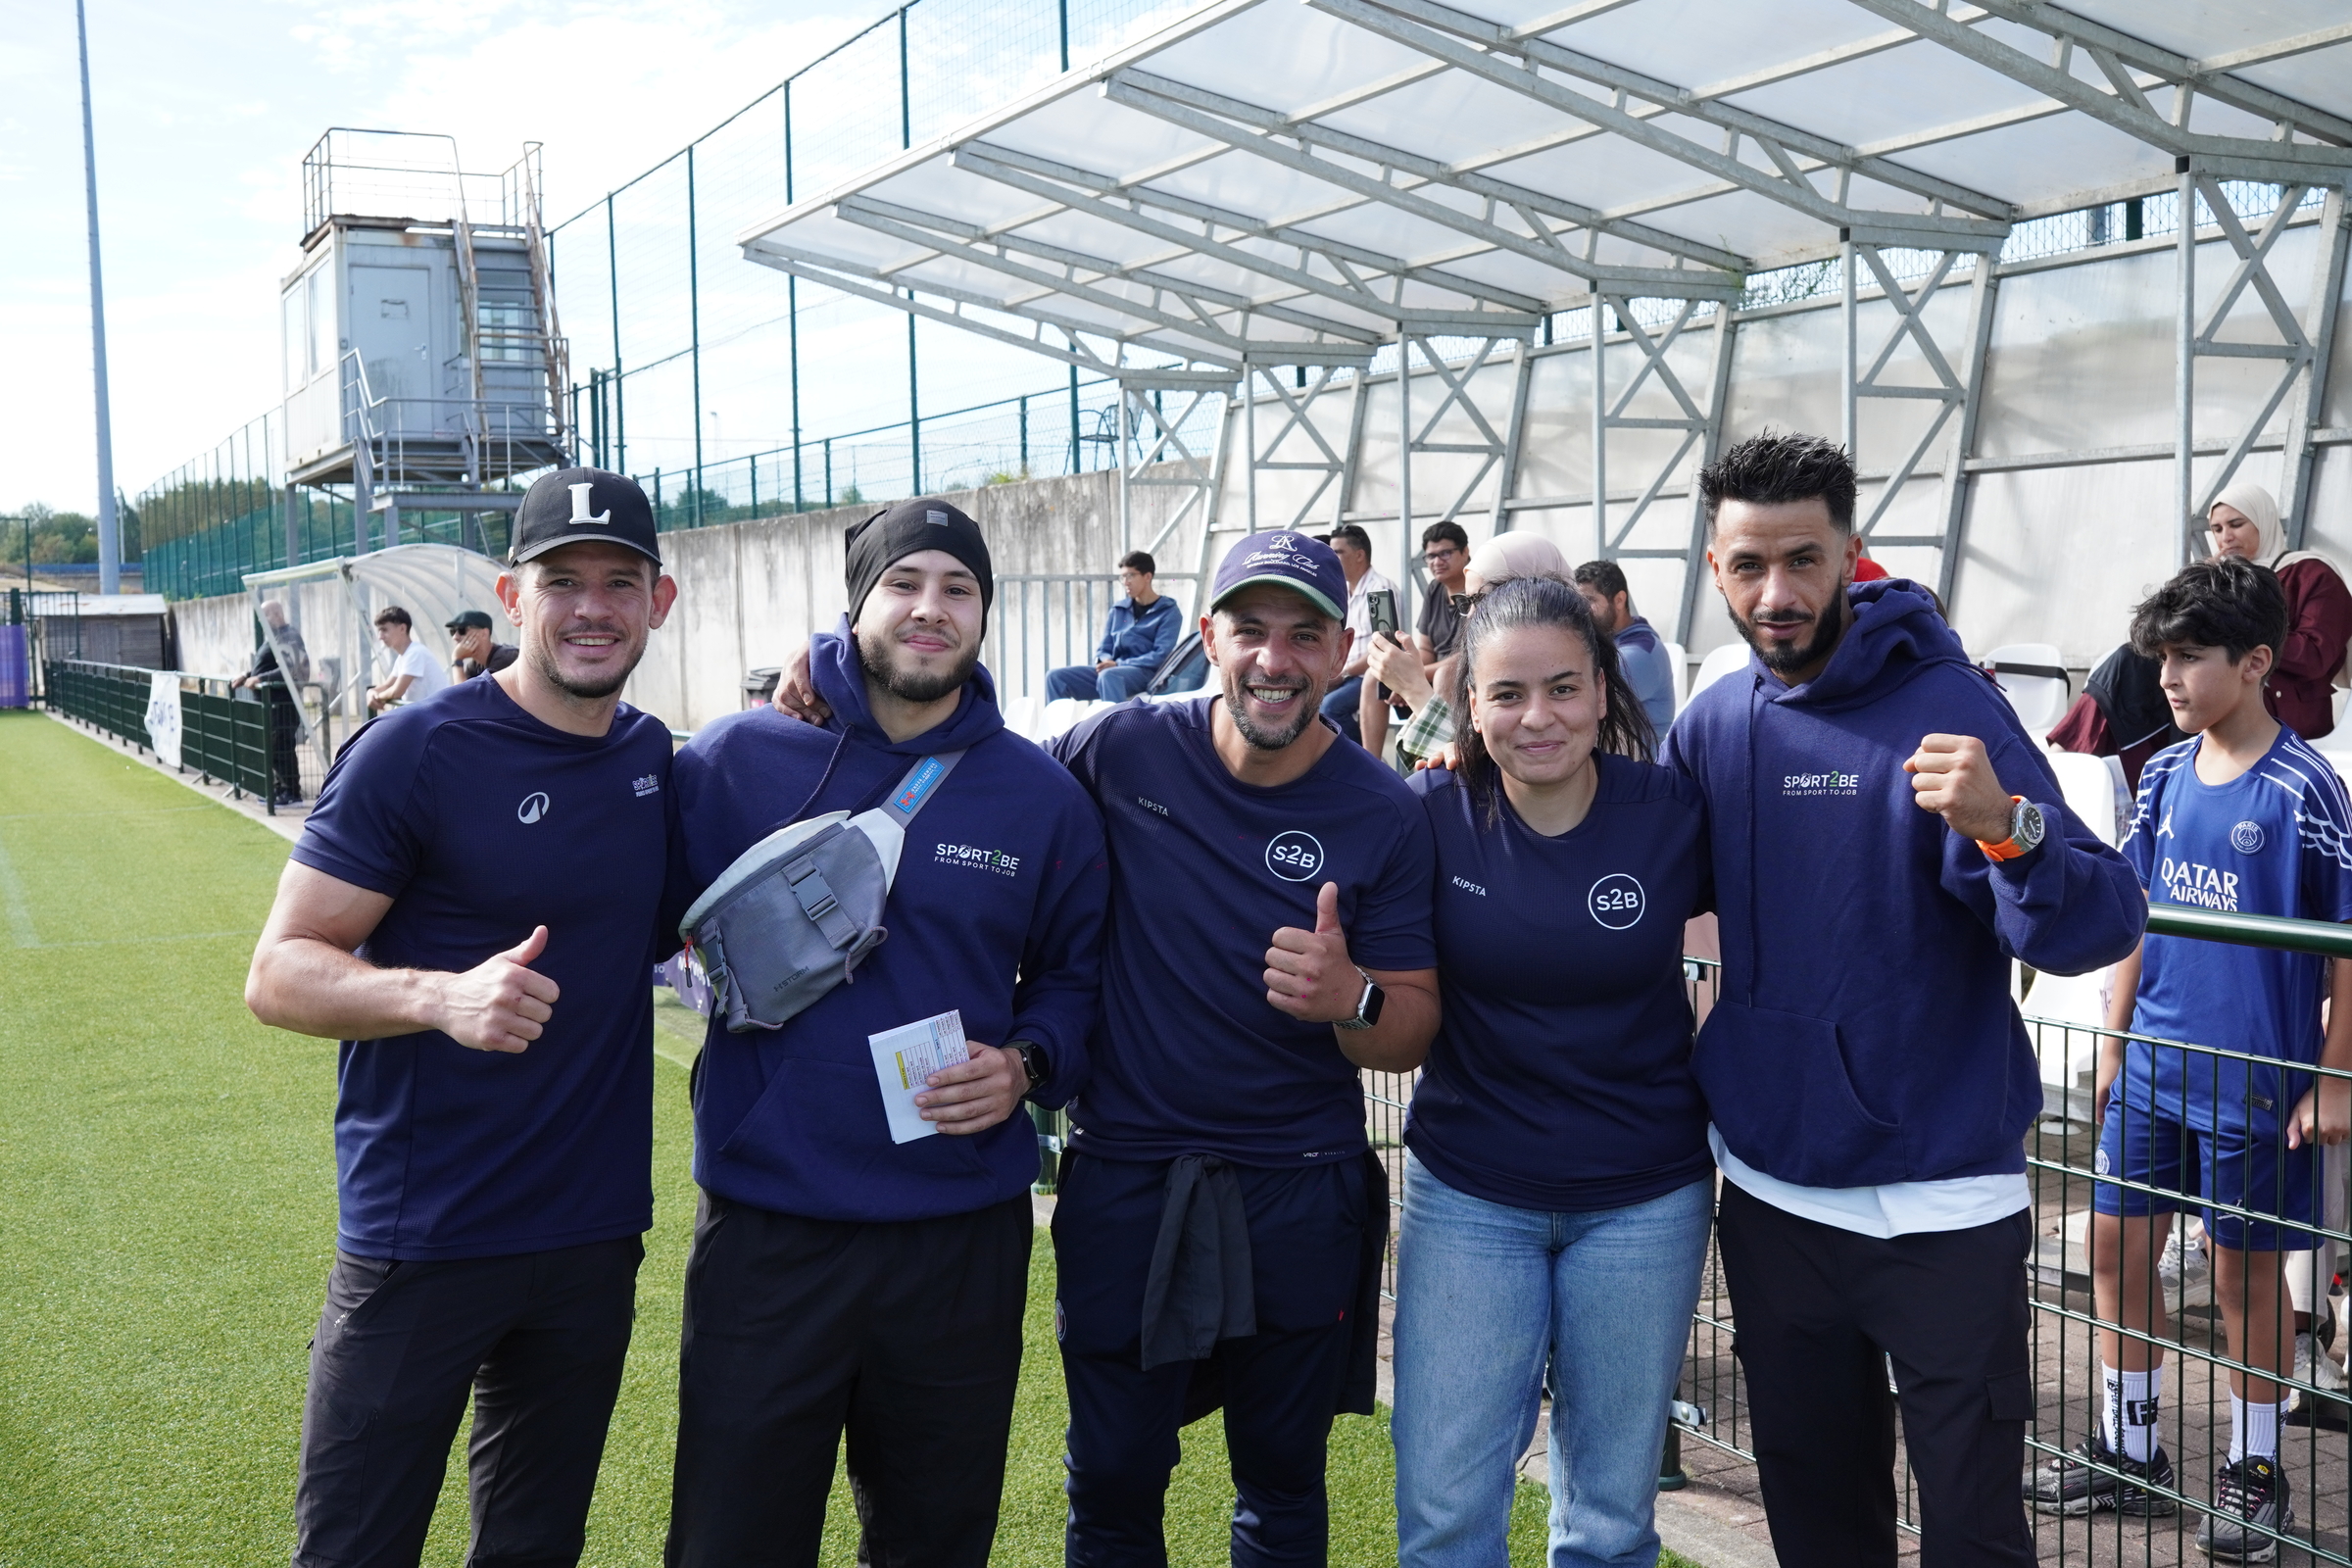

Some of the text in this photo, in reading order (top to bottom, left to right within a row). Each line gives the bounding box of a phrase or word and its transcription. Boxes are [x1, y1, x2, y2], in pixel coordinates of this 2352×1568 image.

[567, 482, 612, 525] L
[1242, 551, 1320, 569] Running Club
[1784, 770, 1860, 789] SPORT2BE
[1138, 797, 1169, 817] KIPSTA
[934, 857, 959, 865] FROM
[961, 860, 989, 870] SPORT
[936, 843, 1020, 870] SPORT2BE
[1272, 845, 1316, 869] S2B
[1452, 875, 1487, 897] KIPSTA
[2161, 858, 2239, 899] QATAR
[1596, 888, 1639, 911] S2B
[2170, 884, 2238, 912] AIRWAYS
[782, 965, 809, 987] STORM
